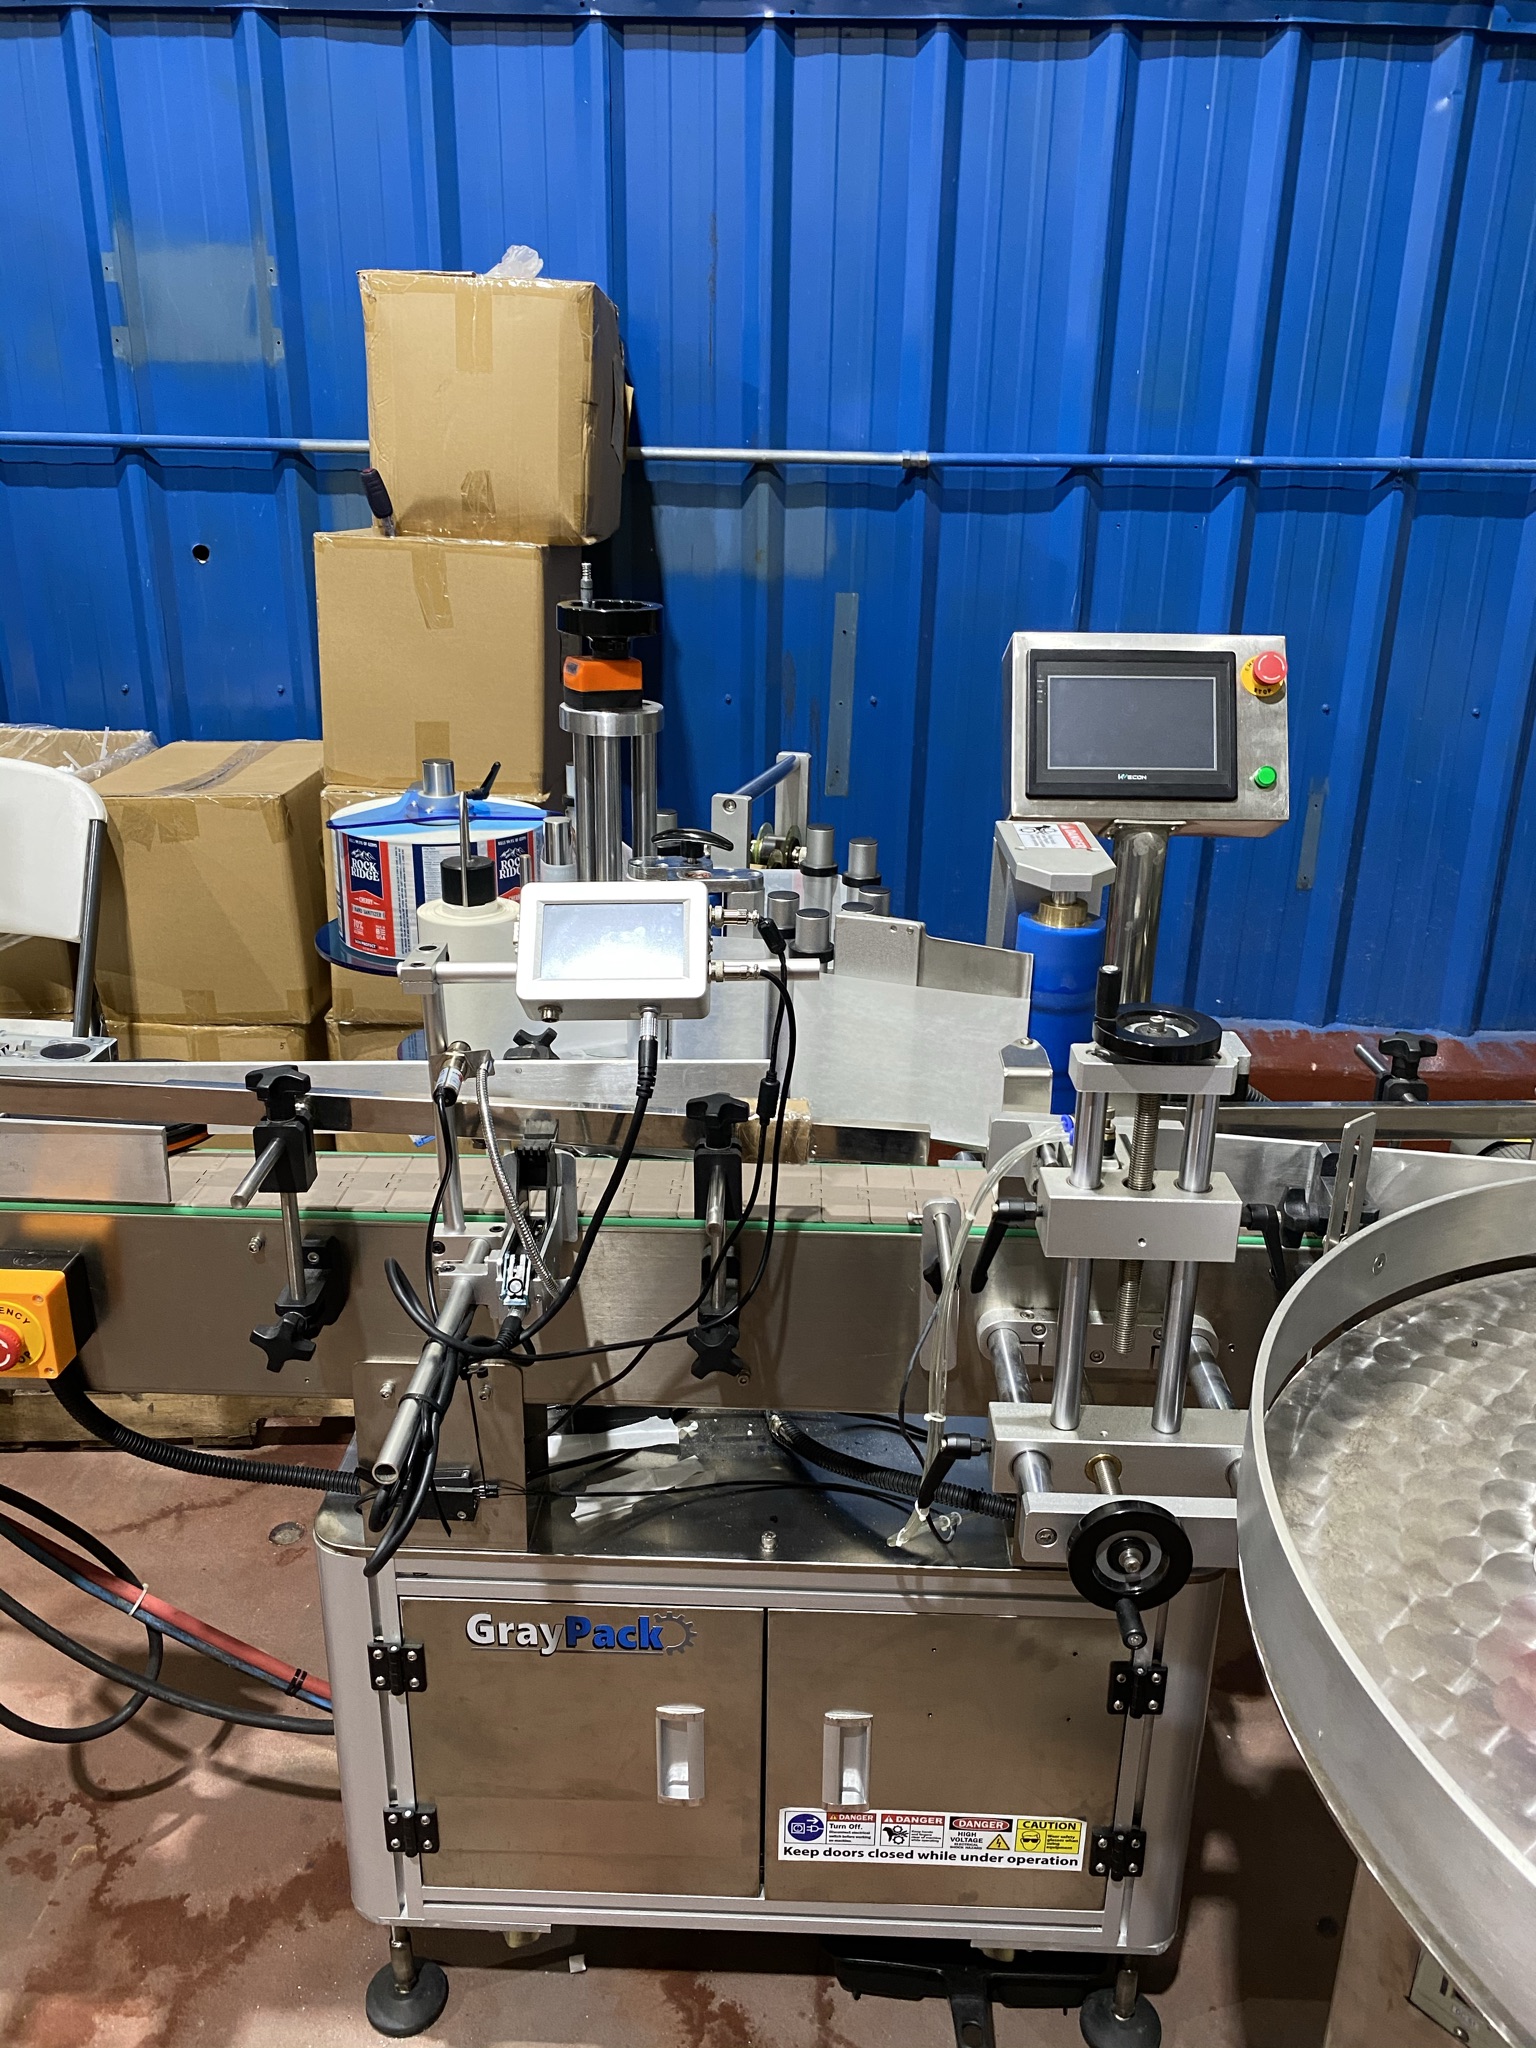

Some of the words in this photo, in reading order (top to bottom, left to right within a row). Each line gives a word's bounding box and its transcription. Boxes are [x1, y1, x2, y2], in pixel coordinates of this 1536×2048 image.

[351, 858, 378, 873] ROCK
[501, 857, 520, 870] ROC
[351, 866, 380, 882] RIDGE
[465, 1612, 665, 1657] GrayPack
[838, 1813, 874, 1821] DANGER
[896, 1816, 943, 1824] DANGER
[958, 1820, 1004, 1829] DANGER
[1023, 1820, 1077, 1830] CAUTION
[783, 1846, 820, 1859] Keep
[823, 1847, 864, 1858] doors
[867, 1848, 914, 1859] closed
[917, 1850, 957, 1862] while
[960, 1852, 1004, 1863] under
[1006, 1854, 1078, 1866] operation
